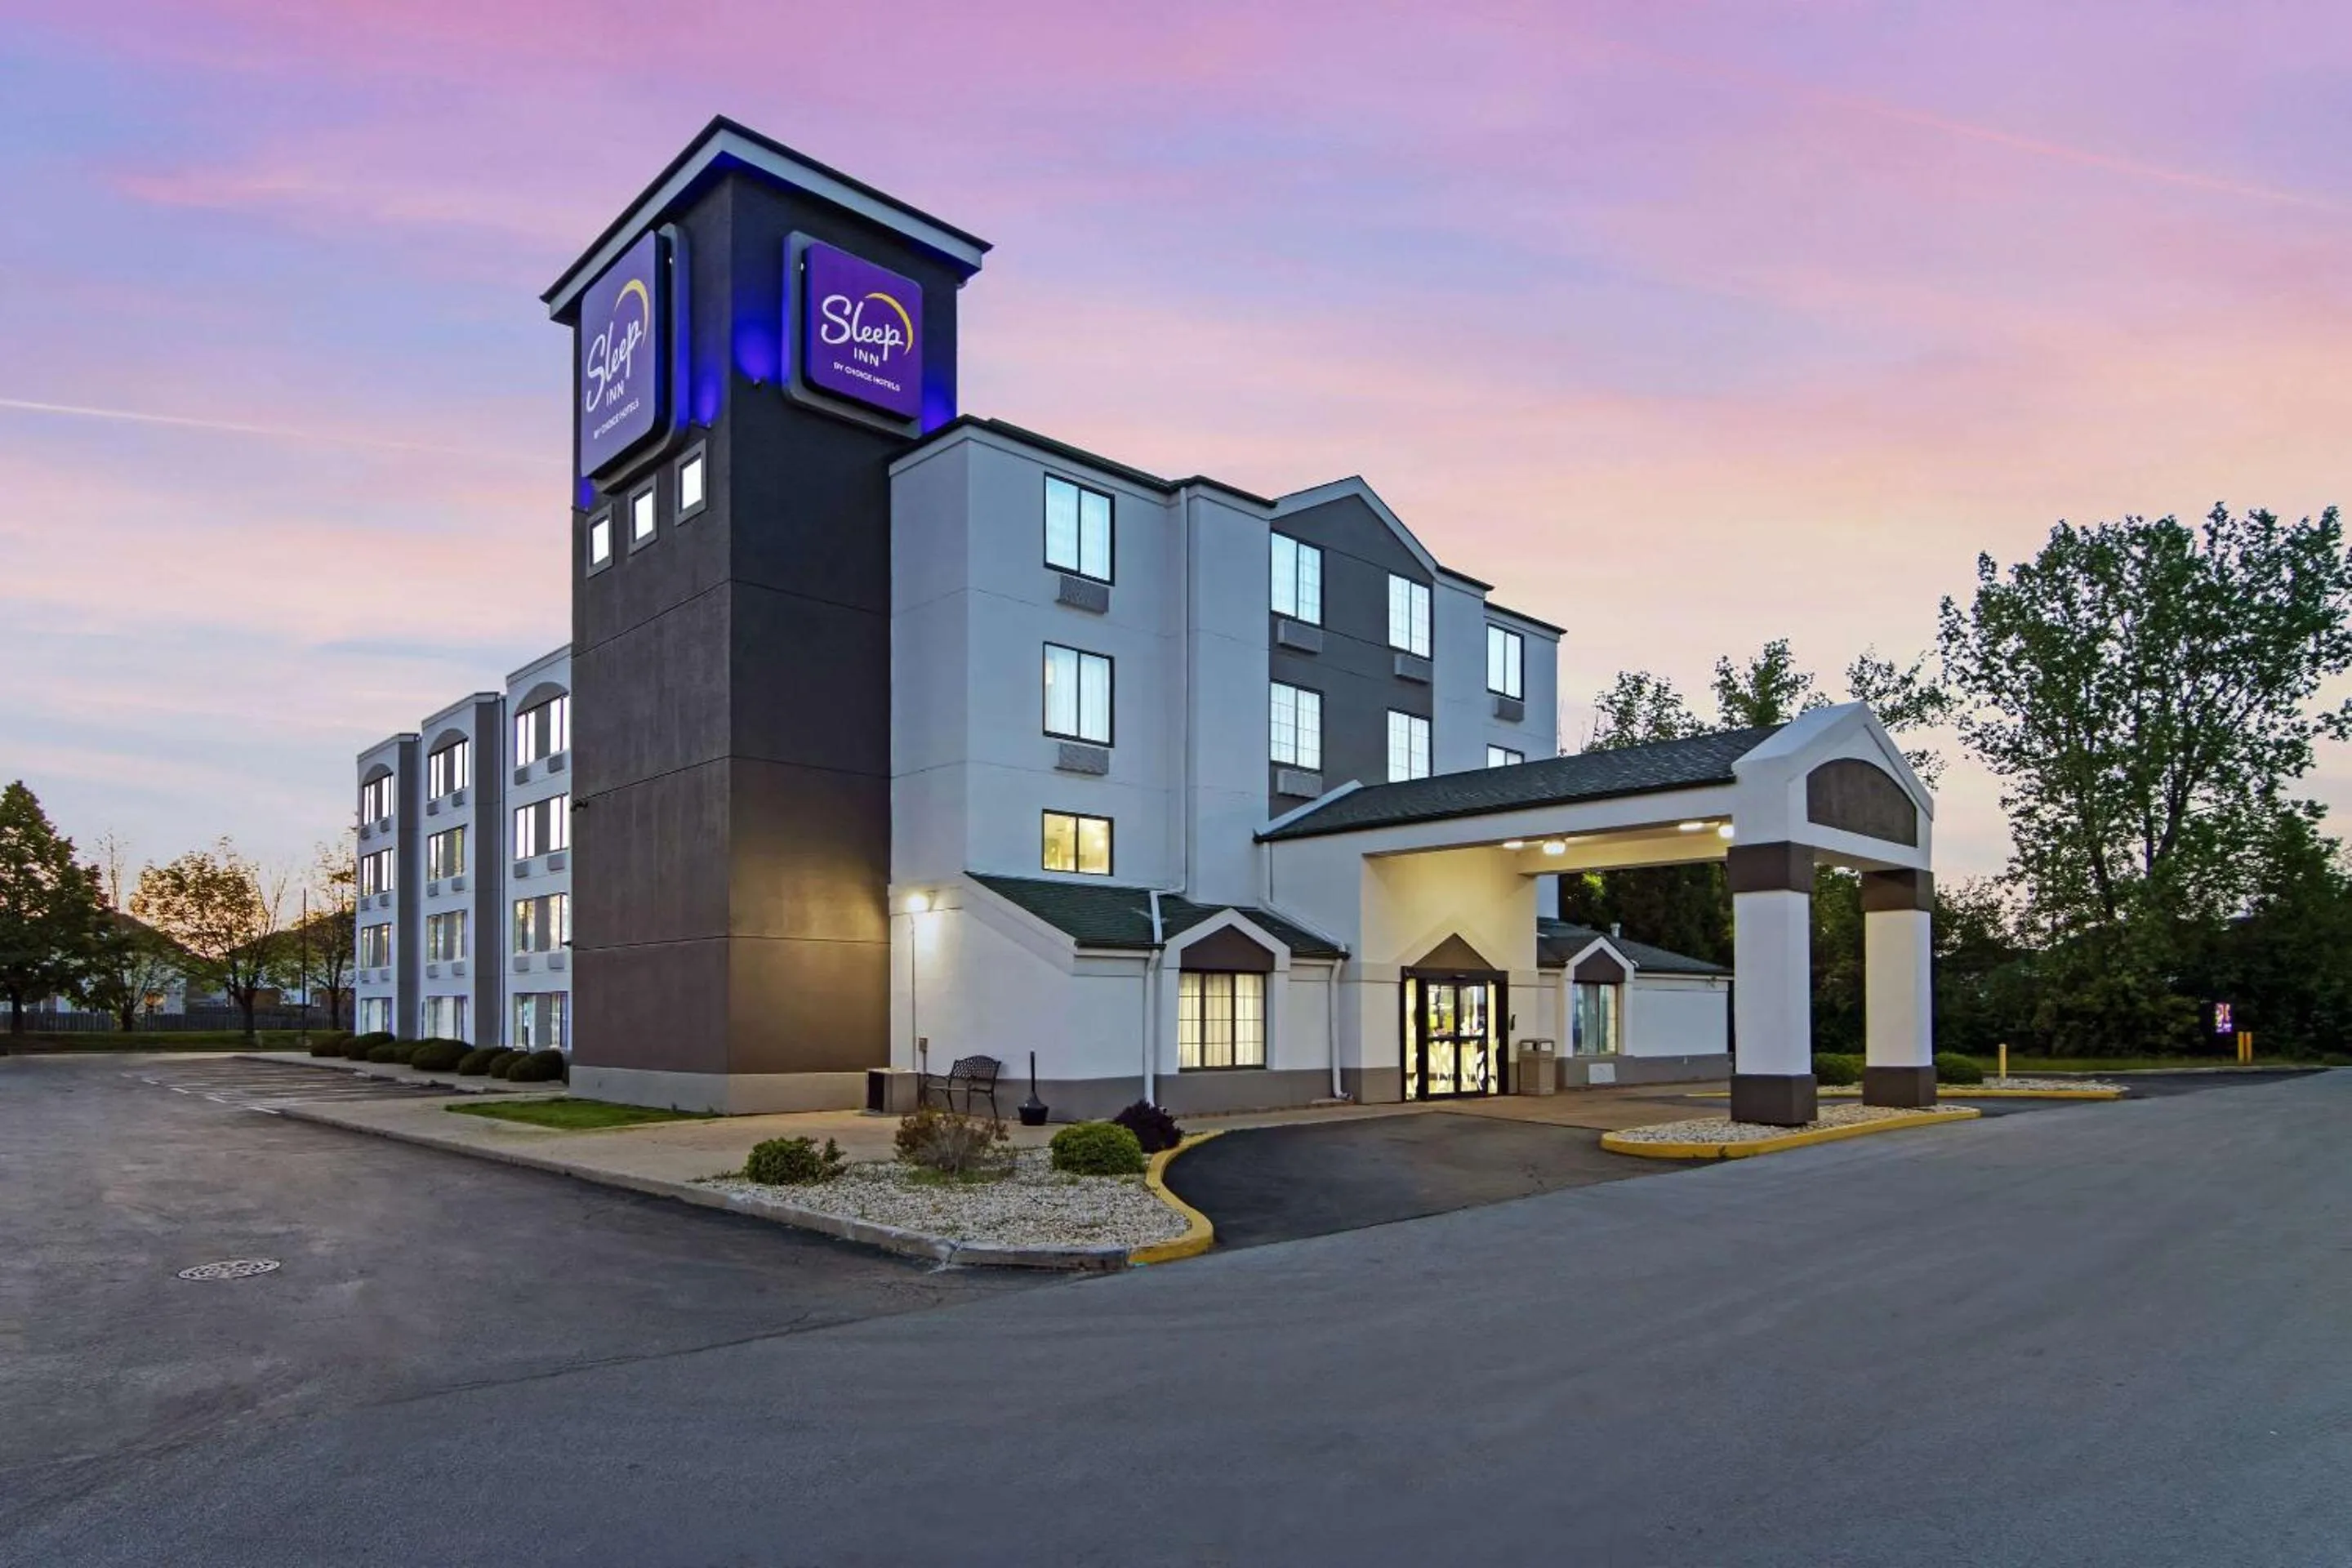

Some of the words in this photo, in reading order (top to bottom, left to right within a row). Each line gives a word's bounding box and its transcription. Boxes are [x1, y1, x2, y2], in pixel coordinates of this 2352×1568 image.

[821, 295, 904, 361] Sleep
[586, 320, 642, 412] Sleep
[853, 346, 879, 367] INN
[606, 380, 626, 407] INN
